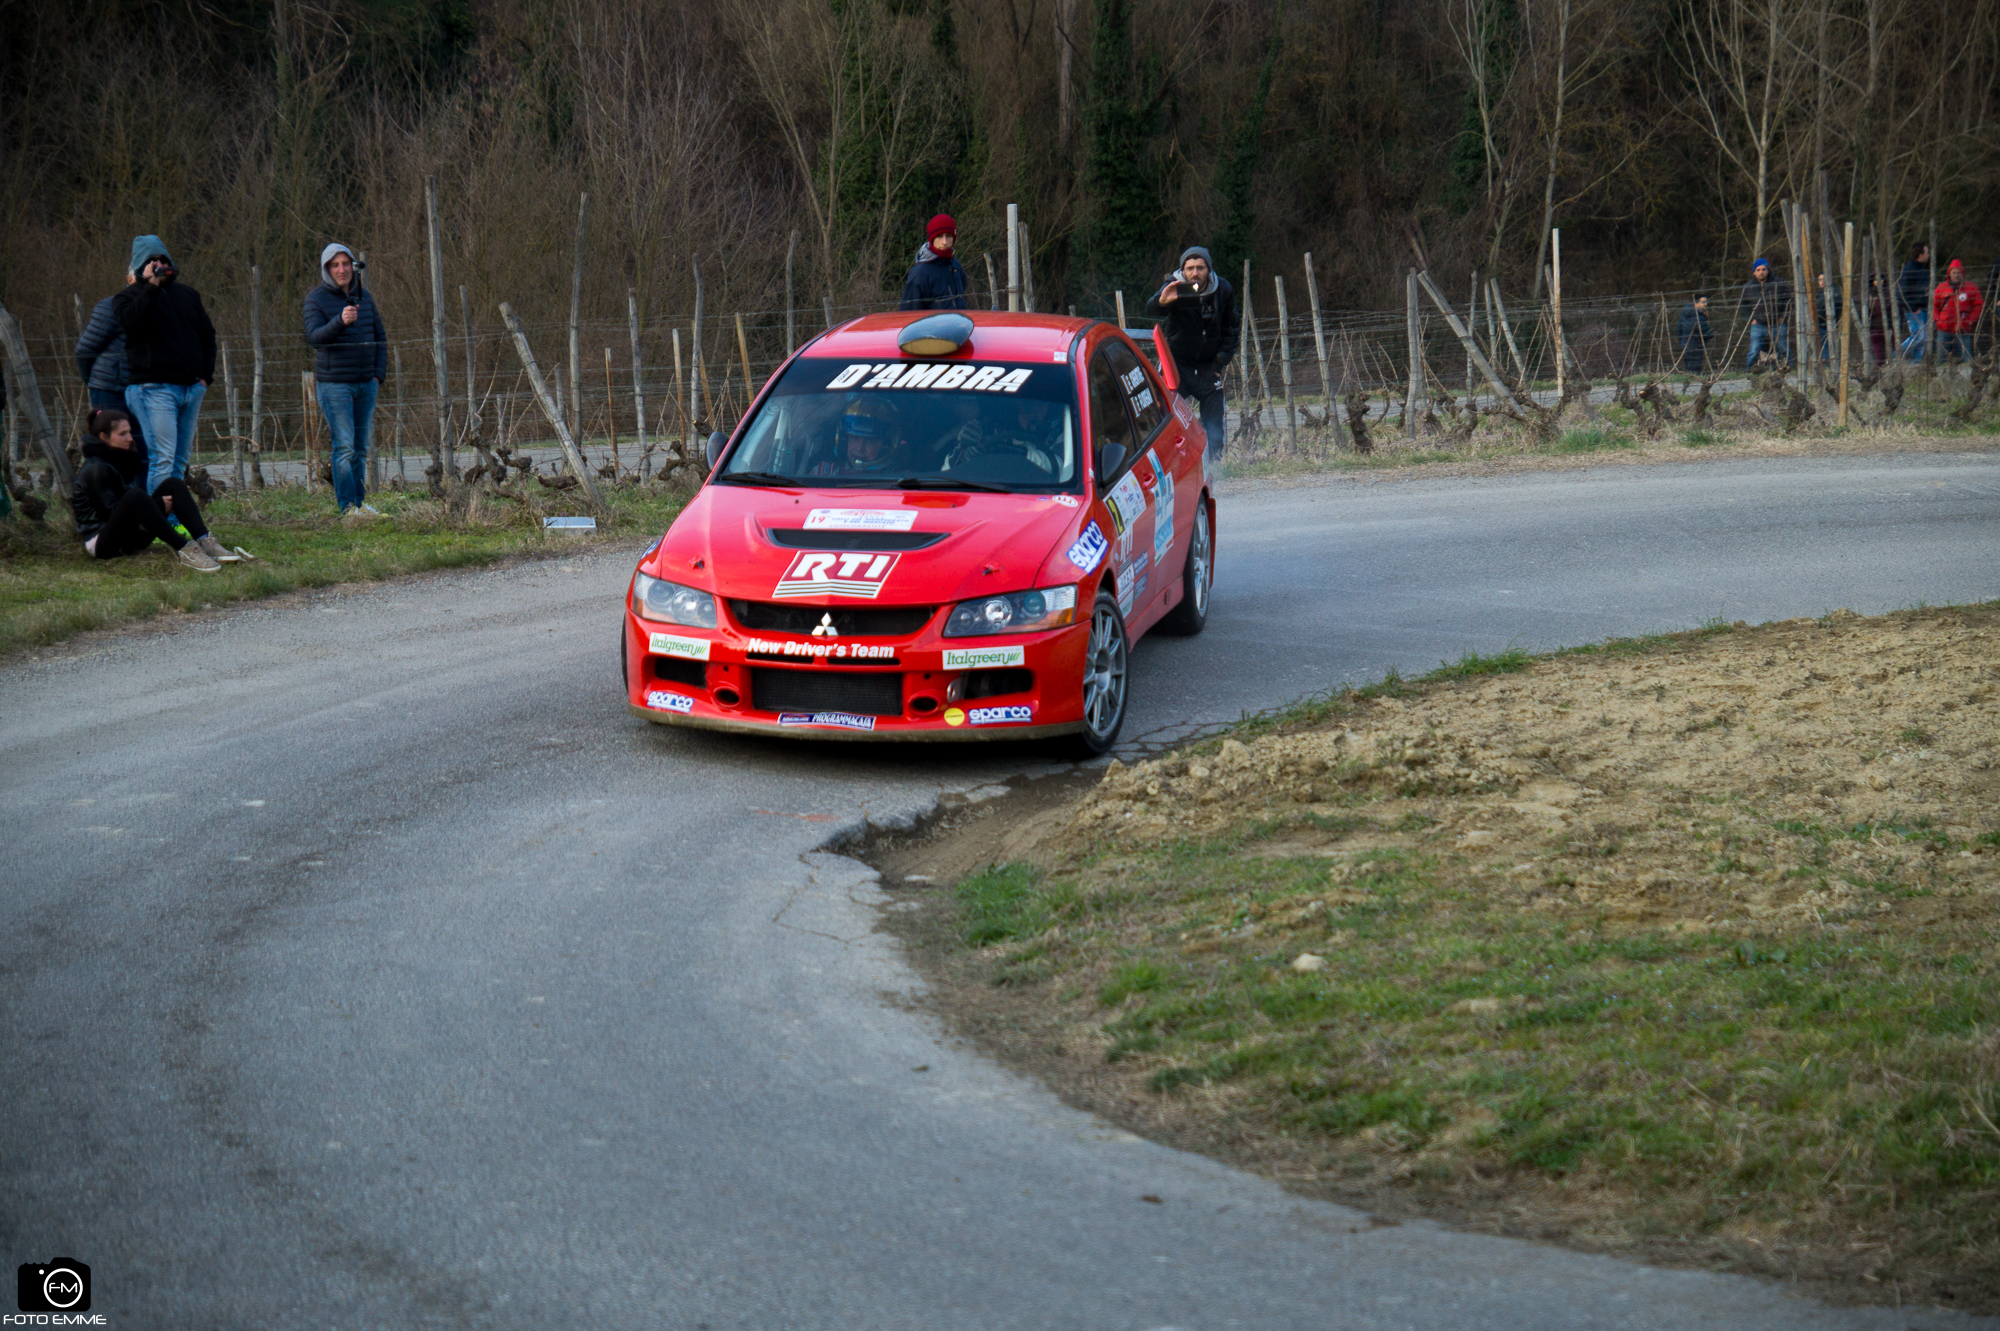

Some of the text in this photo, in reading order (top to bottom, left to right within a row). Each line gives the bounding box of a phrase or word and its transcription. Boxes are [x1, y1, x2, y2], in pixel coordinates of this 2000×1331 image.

[826, 363, 1034, 392] D'AMBRA
[1107, 498, 1124, 534] 2
[1069, 520, 1104, 568] sparco
[791, 553, 891, 582] RTI
[651, 634, 698, 656] Italgreen
[748, 638, 895, 658] New Driver's Team
[946, 650, 1011, 667] Italgreen
[648, 691, 694, 709] sparco
[969, 706, 1032, 724] sparco
